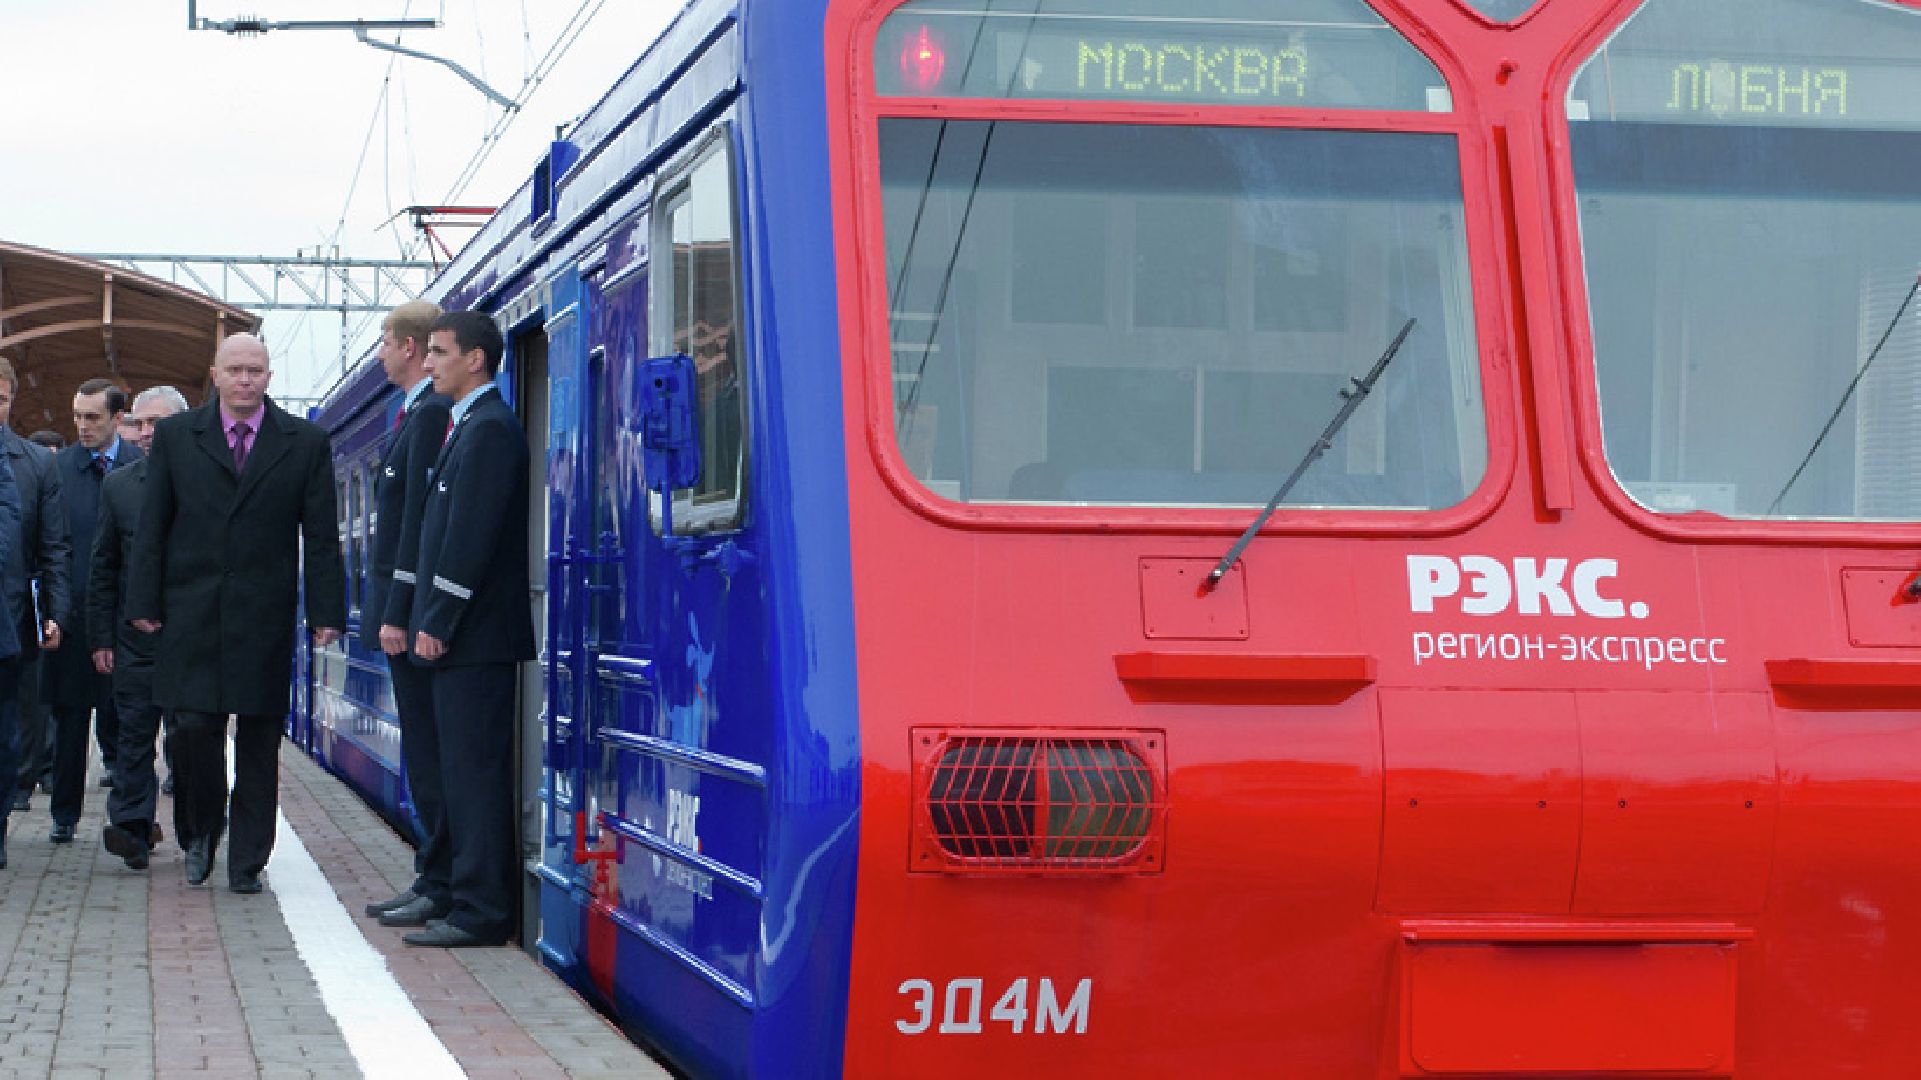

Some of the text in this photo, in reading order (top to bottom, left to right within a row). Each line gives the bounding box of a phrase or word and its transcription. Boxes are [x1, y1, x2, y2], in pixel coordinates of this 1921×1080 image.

[1077, 41, 1308, 97] МОСКВА
[1665, 63, 1848, 114] ЛОБНЯ
[1406, 554, 1650, 619] РЭКС.
[1412, 631, 1729, 671] регион-экспресс
[894, 977, 1092, 1035] ЭД4М
